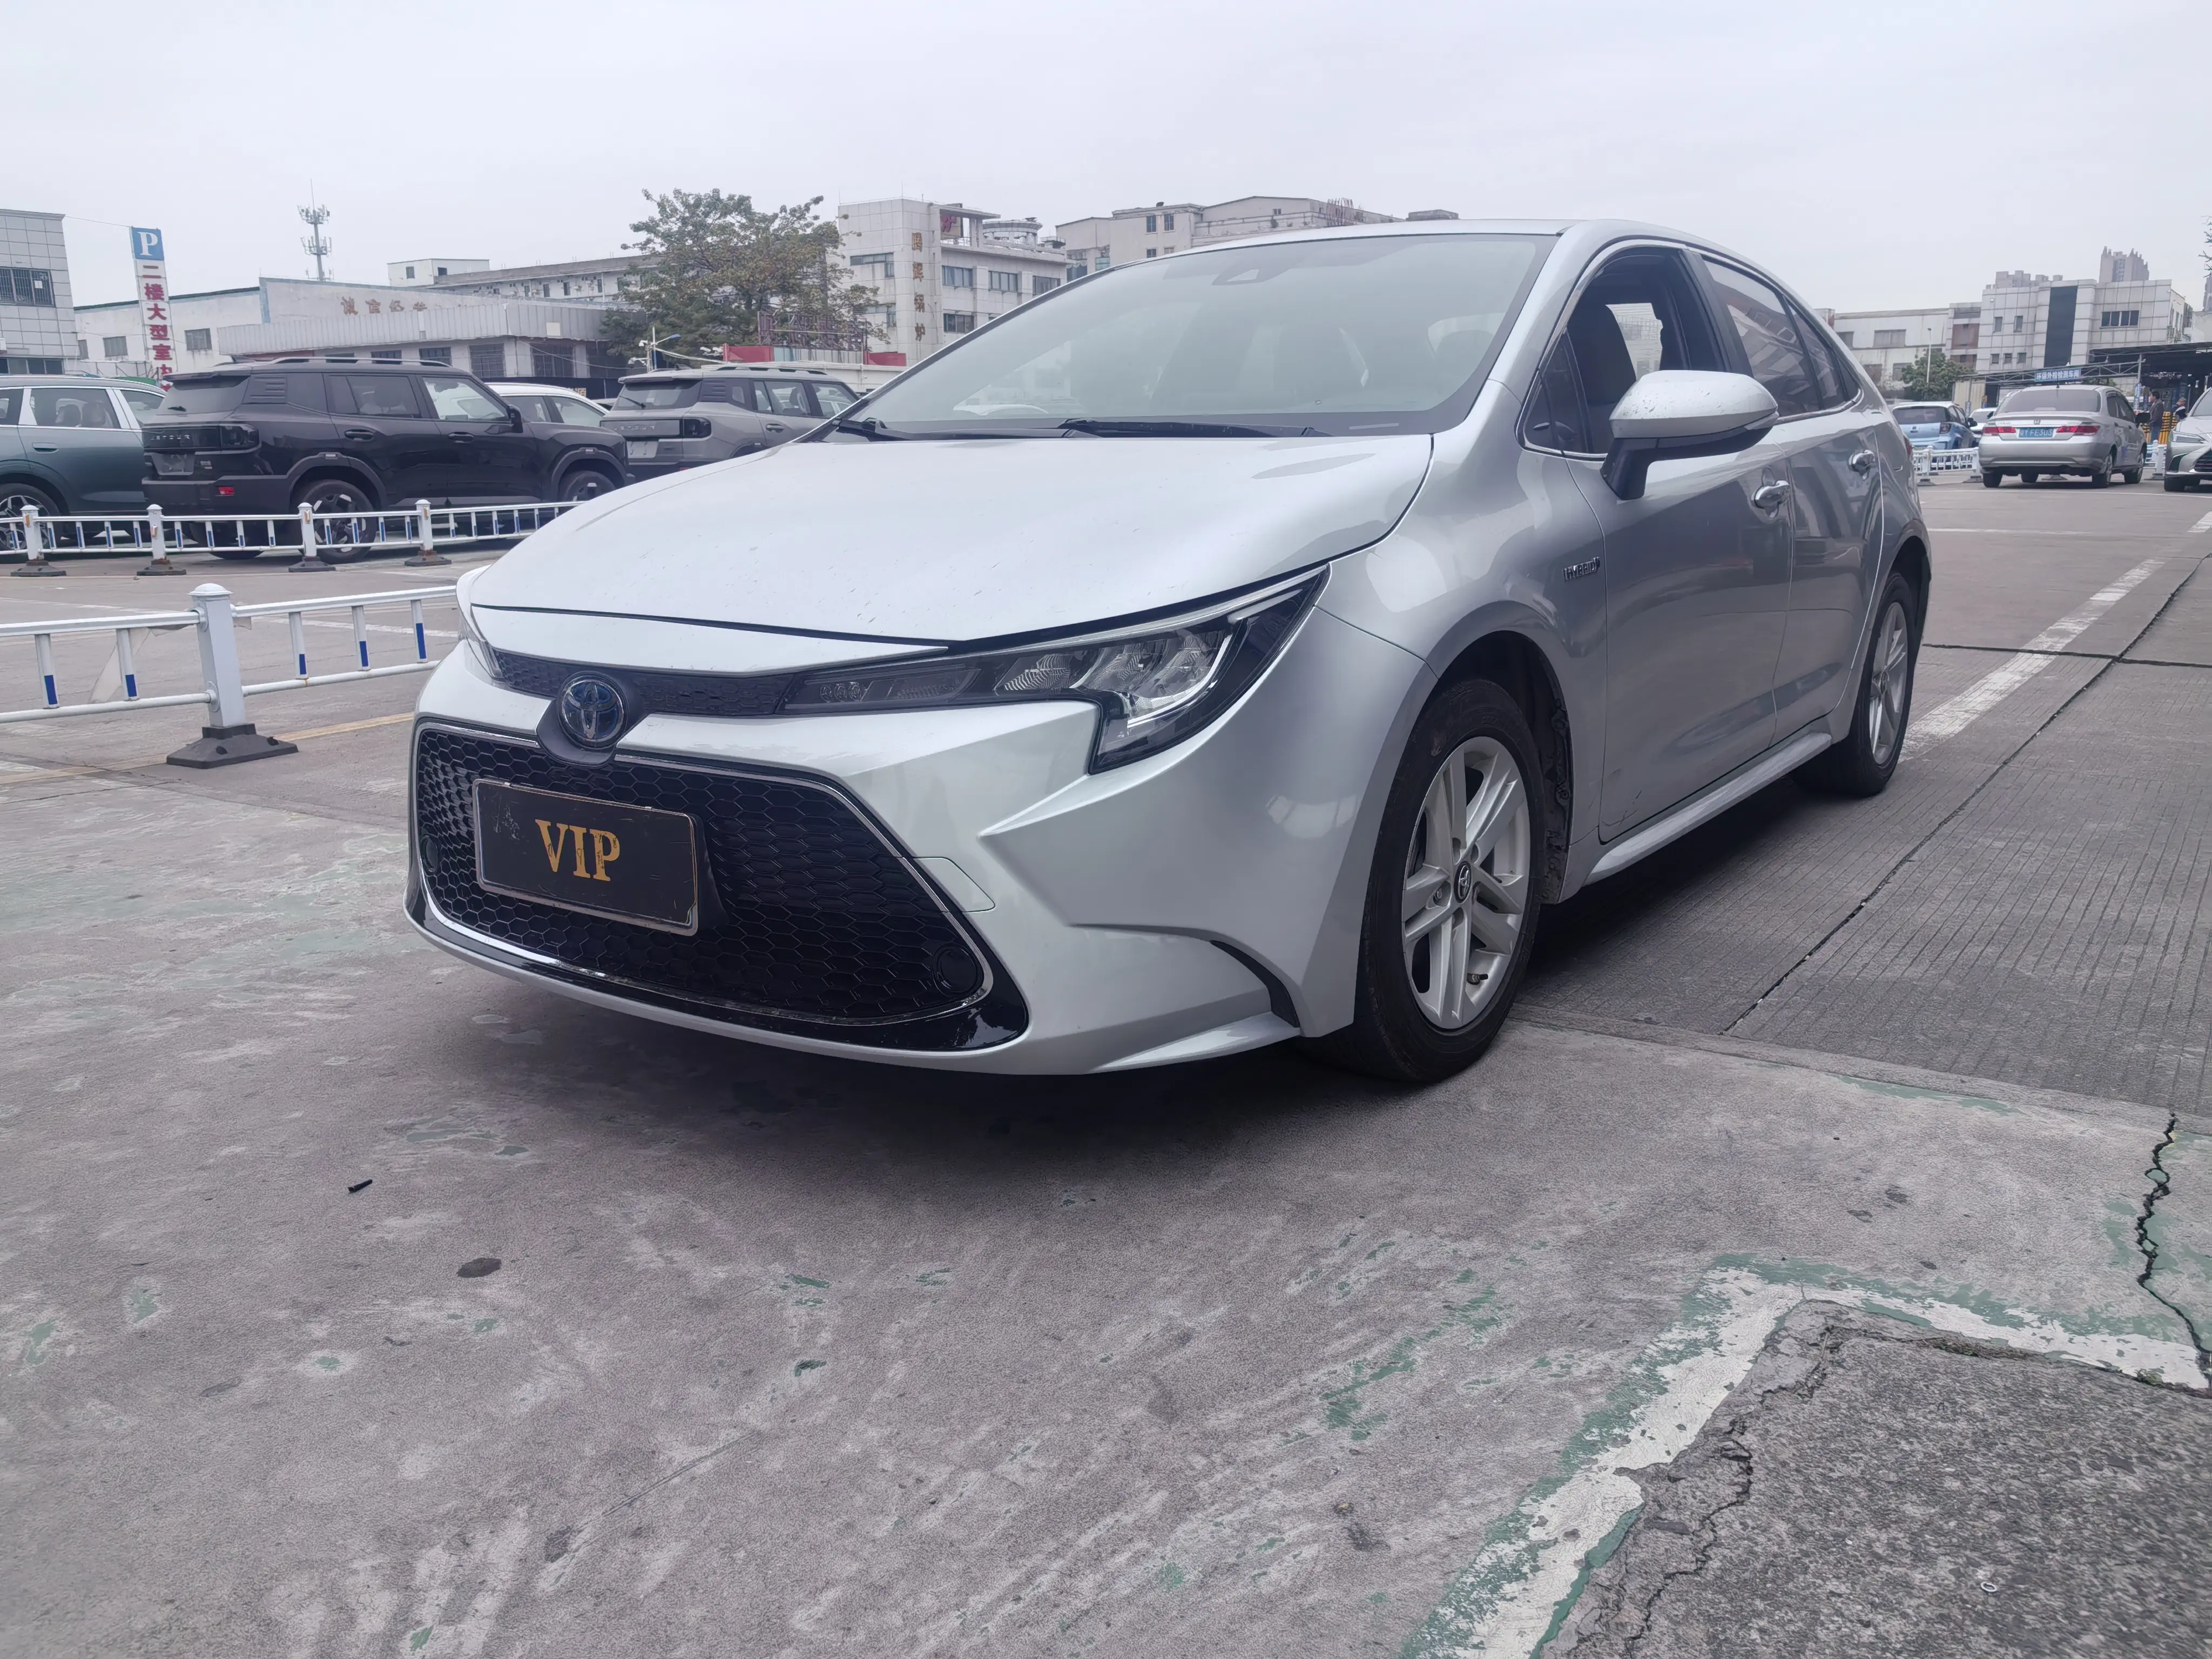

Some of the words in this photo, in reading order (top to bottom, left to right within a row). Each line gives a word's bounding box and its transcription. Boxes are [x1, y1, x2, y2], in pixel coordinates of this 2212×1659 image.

[137, 231, 158, 256] P
[1562, 559, 1597, 581] HYBRID
[535, 819, 620, 881] VIP
